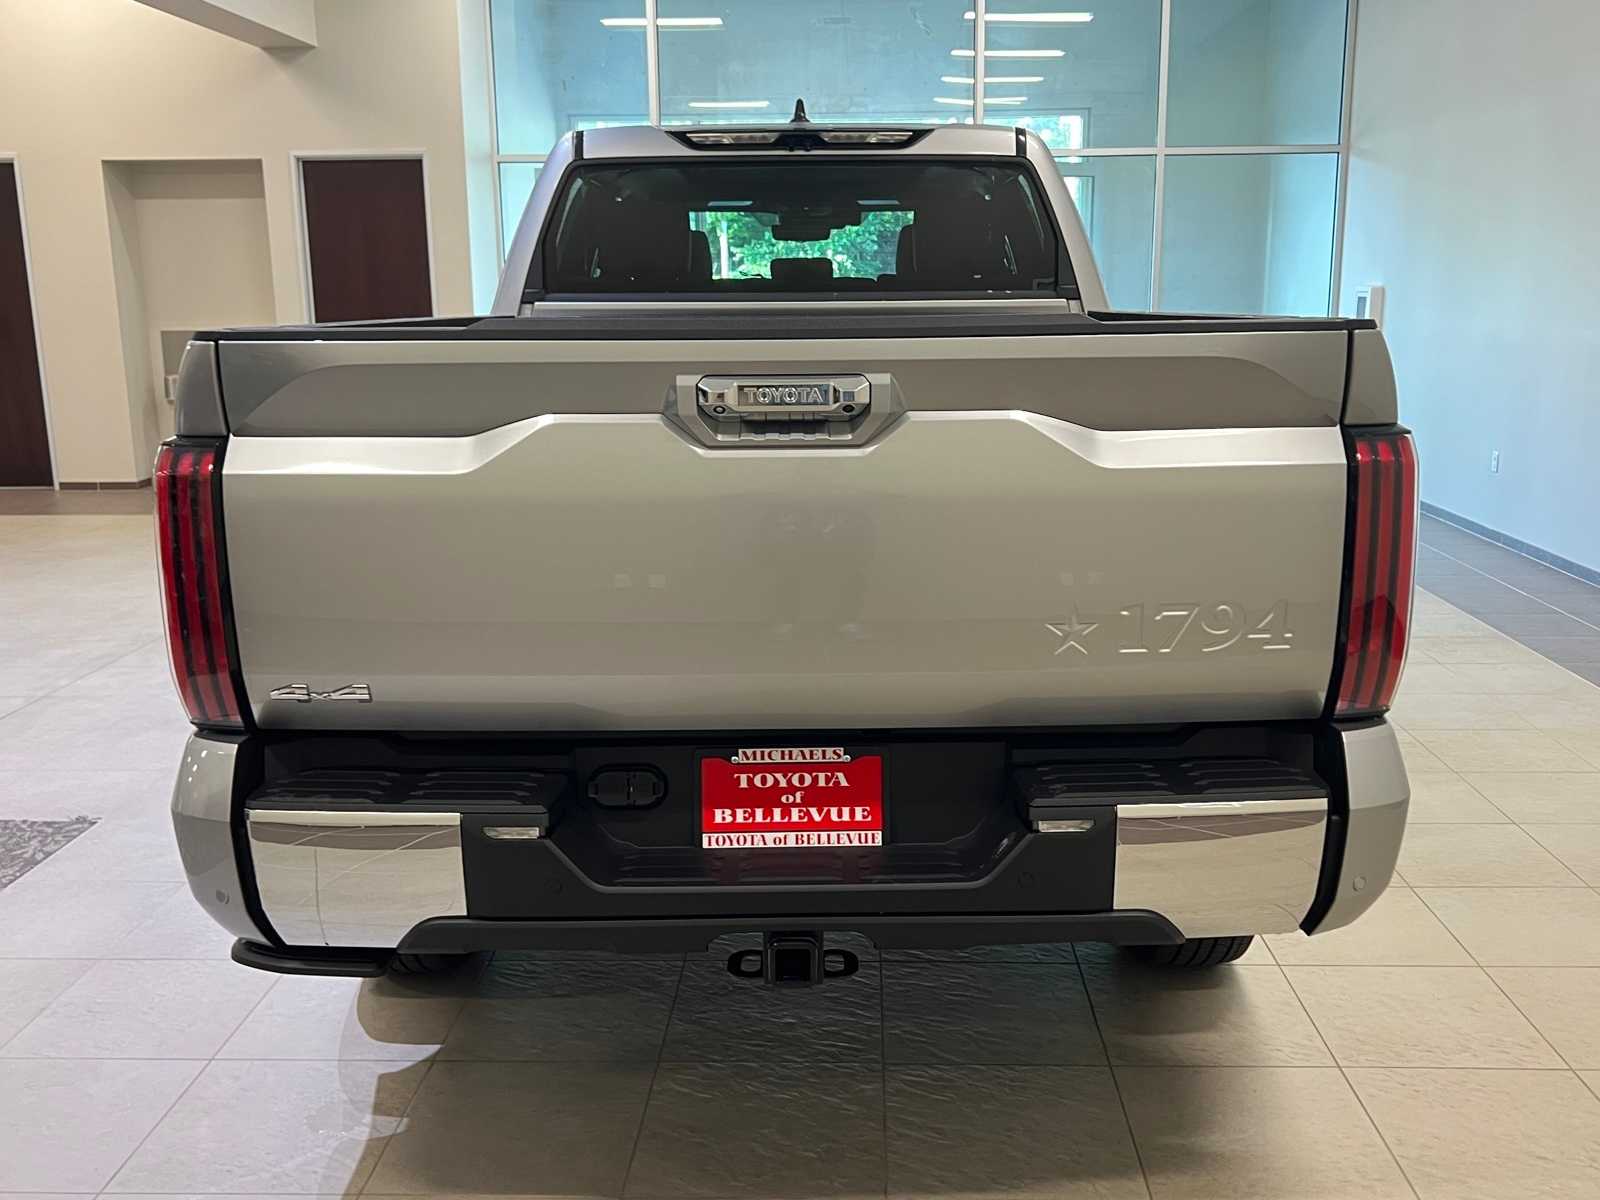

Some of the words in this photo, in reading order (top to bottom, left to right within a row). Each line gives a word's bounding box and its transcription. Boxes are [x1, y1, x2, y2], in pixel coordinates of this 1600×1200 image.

[743, 387, 824, 403] TOYOTA
[1118, 600, 1293, 652] 1794
[740, 748, 843, 762] MICHAELS
[734, 772, 850, 788] TOYOTA
[780, 791, 805, 804] of
[713, 806, 872, 824] BELLEVUE
[705, 834, 768, 847] TOYOTA
[773, 833, 790, 846] of
[795, 832, 880, 846] BELLEVUE
